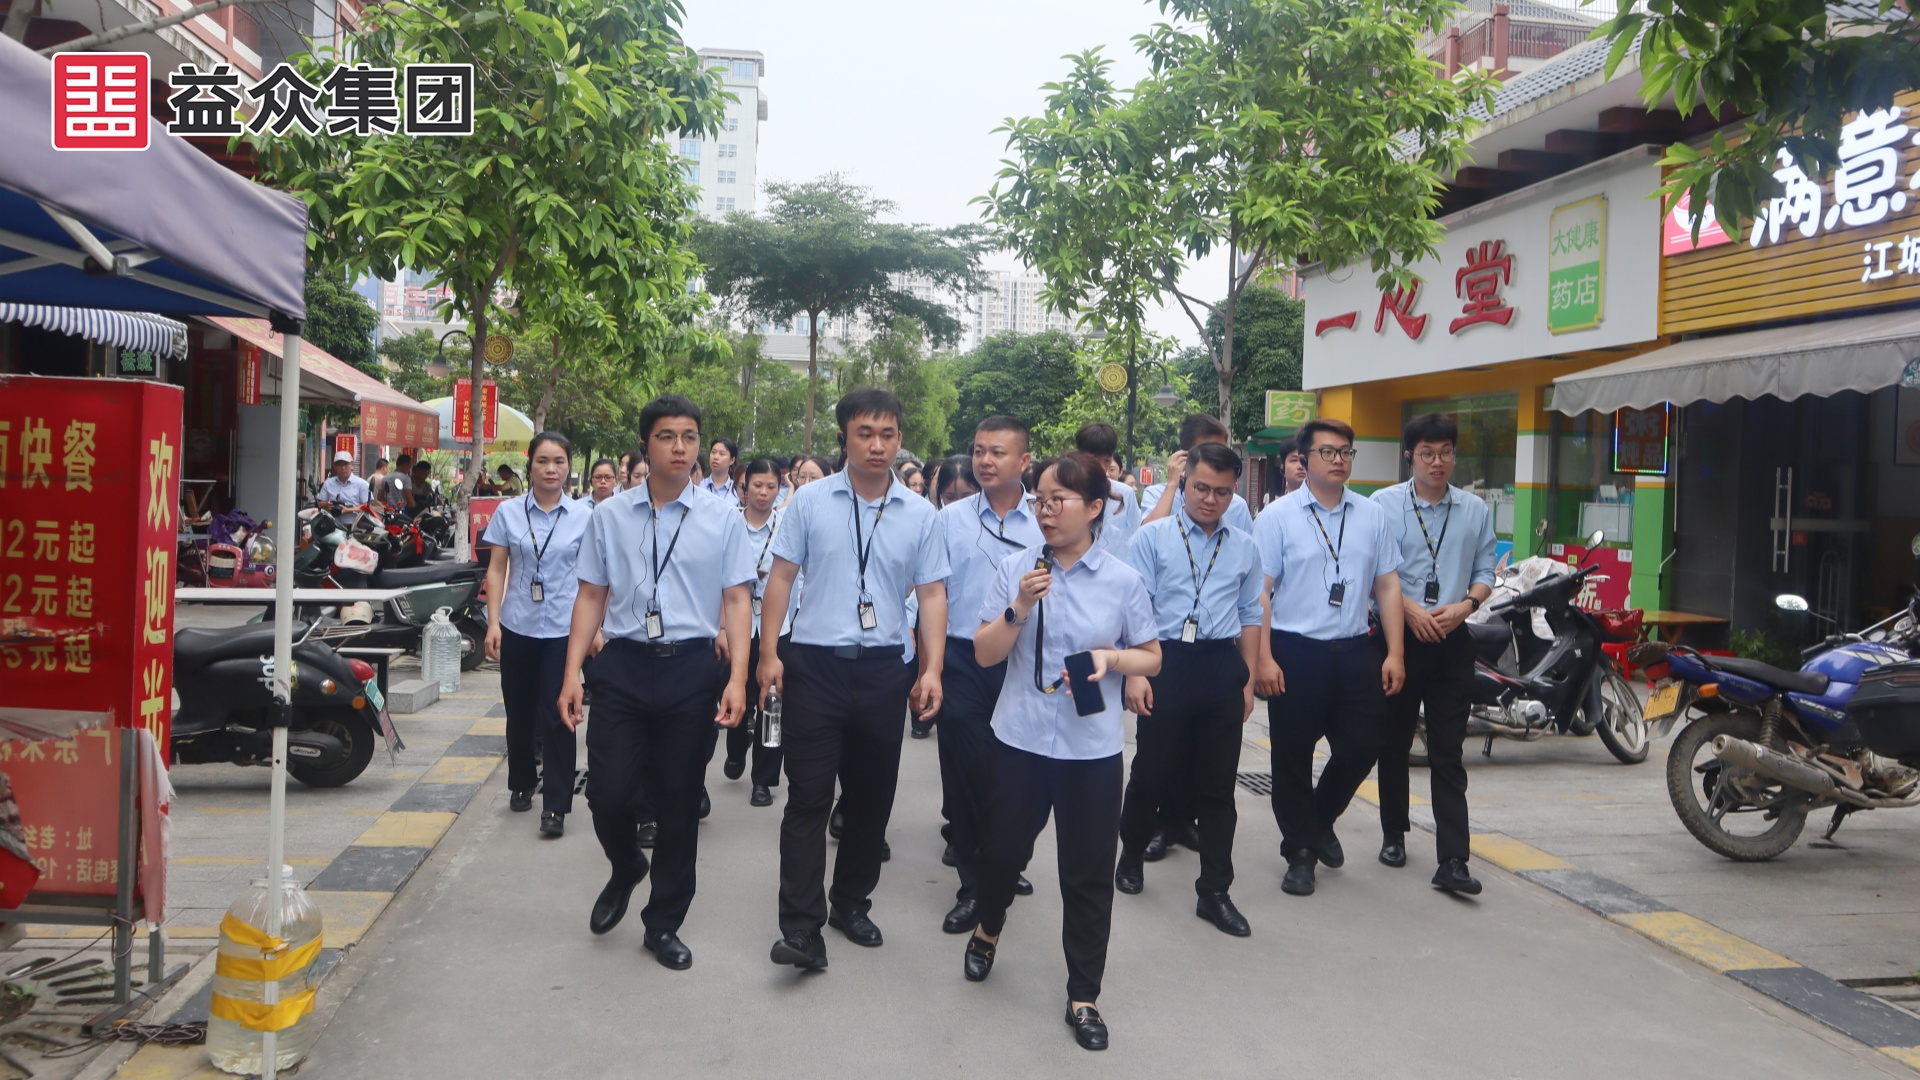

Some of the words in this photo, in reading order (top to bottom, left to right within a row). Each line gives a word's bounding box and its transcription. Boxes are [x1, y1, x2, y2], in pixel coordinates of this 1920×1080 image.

[1750, 105, 1920, 248] 满意
[1552, 219, 1599, 256] 大健康
[1315, 239, 1515, 341] 一心堂
[1551, 273, 1598, 311] 药店
[1273, 398, 1313, 423] 药
[0, 574, 93, 618] 2元起
